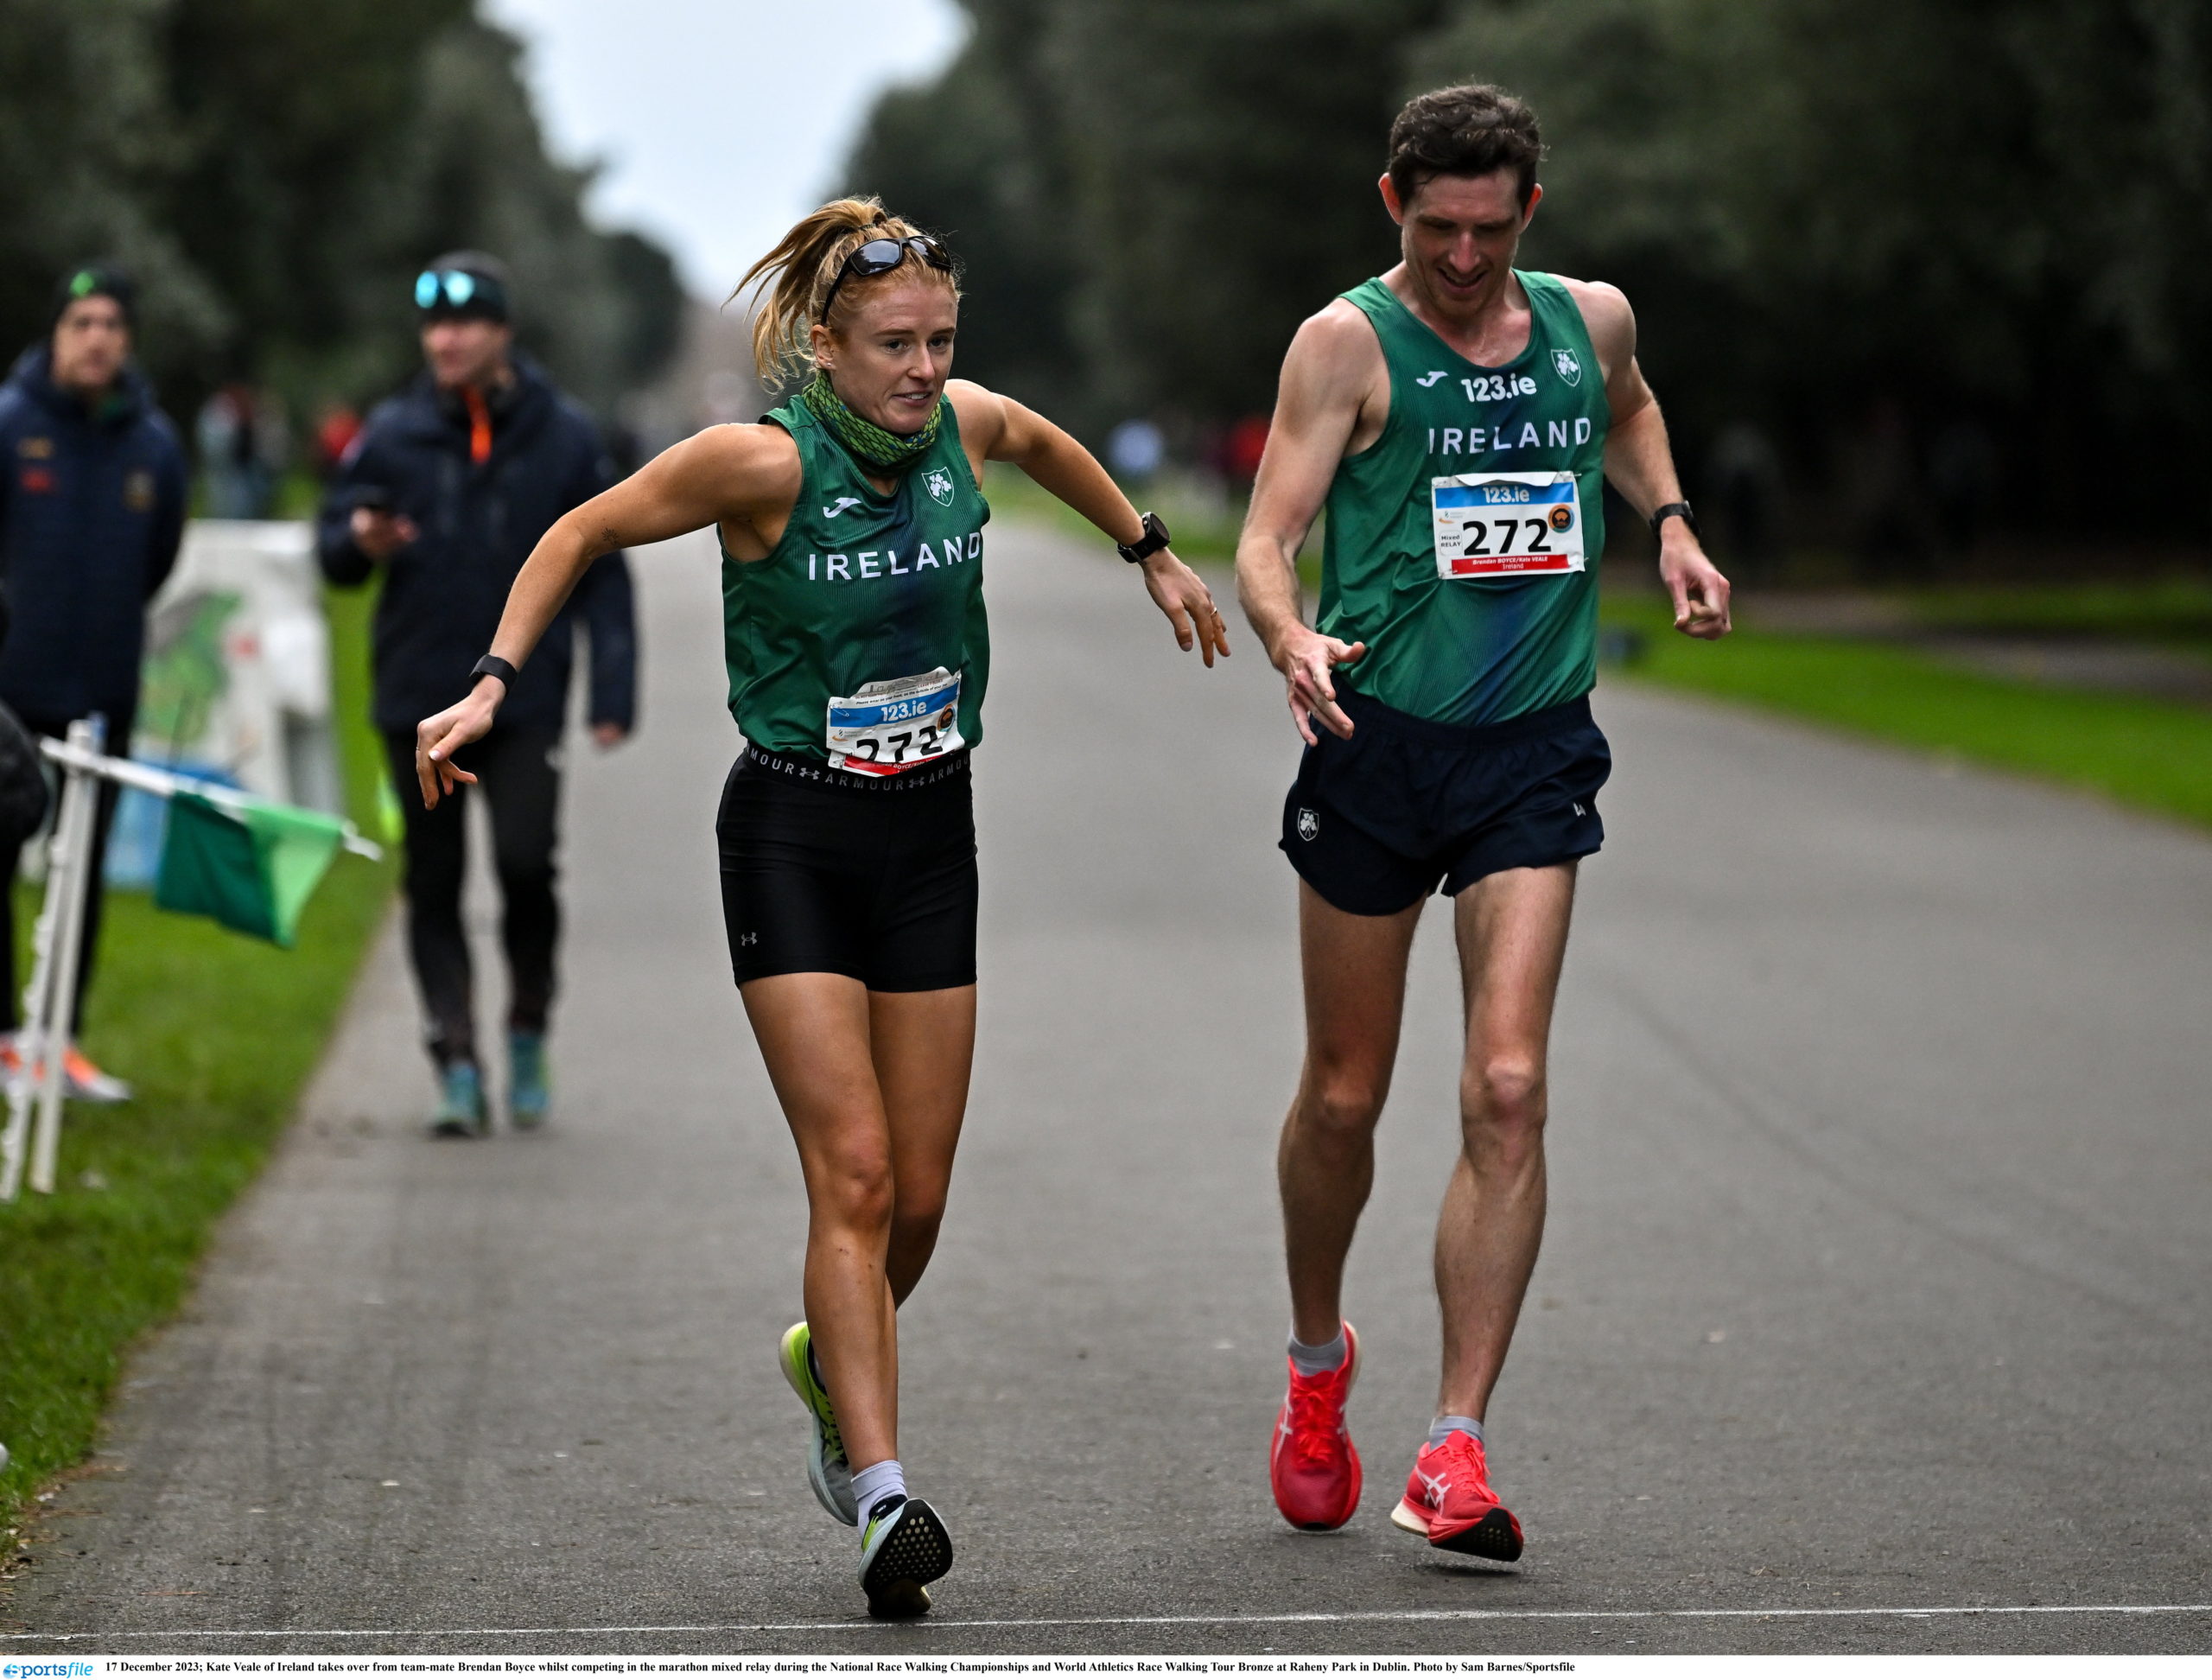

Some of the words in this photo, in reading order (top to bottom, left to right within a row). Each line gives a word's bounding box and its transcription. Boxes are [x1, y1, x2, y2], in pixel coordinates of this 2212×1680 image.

[1460, 372, 1537, 403] 123.ie
[1428, 417, 1591, 455] IRELAND
[1483, 486, 1530, 504] 123.ie
[1462, 518, 1552, 557] 272
[808, 531, 981, 581] IRELAND
[880, 699, 927, 722] 123.ie
[856, 725, 944, 762] 272
[824, 772, 904, 791] ARMOUR
